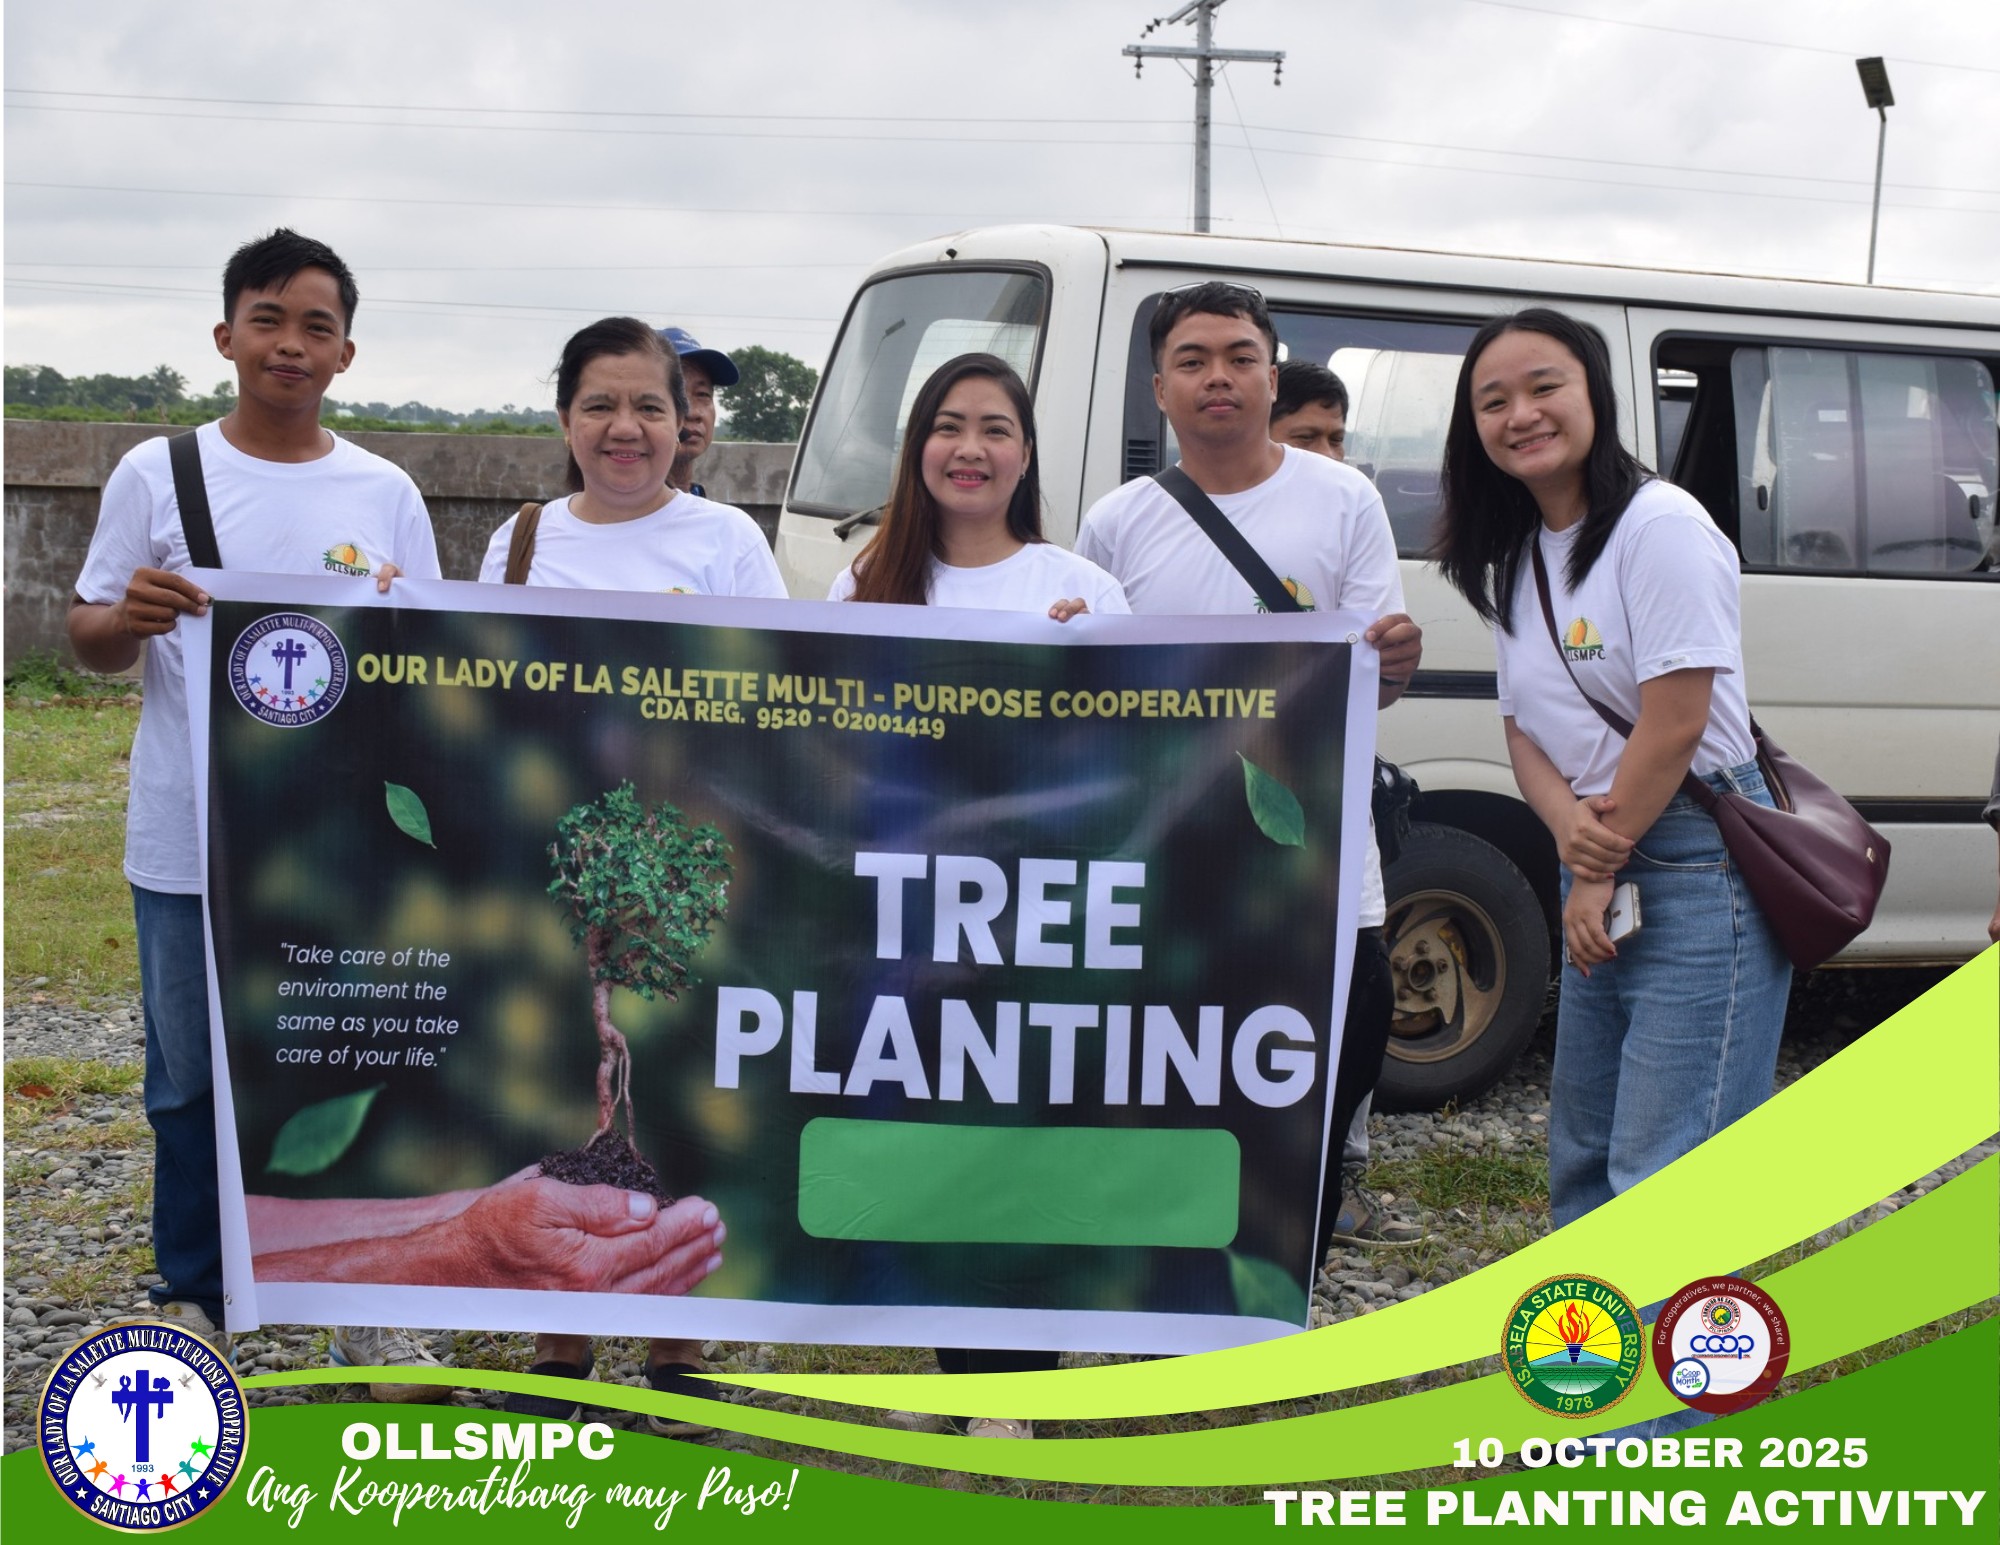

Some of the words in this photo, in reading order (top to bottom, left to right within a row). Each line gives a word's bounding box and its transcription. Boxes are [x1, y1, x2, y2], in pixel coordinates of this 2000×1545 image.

[247, 617, 281, 641] SALETTE
[282, 616, 337, 651] MULTI-PURPOSE
[235, 650, 247, 660] OF
[238, 639, 253, 651] LA
[233, 662, 244, 684] LADY
[324, 651, 345, 704] COOPERATIVE
[236, 684, 252, 701] OUR
[357, 653, 428, 685] OUR
[436, 656, 518, 690] LADY
[524, 661, 567, 692] OF
[574, 664, 613, 694] LA
[620, 666, 759, 702] SALETTE
[767, 672, 866, 707] MULTI
[895, 683, 1042, 718] PURPOSE
[1050, 688, 1277, 719] COOPERATIVE
[257, 706, 298, 724] SANTIAGO
[299, 707, 317, 722] CITY
[641, 698, 690, 720] CDA
[694, 700, 746, 724] REG.
[756, 706, 812, 730] 9520
[854, 852, 1146, 970] TREE
[281, 942, 334, 964] "Take
[339, 950, 386, 965] care
[391, 947, 413, 967] of
[417, 948, 451, 968] the
[277, 977, 409, 999] environment
[414, 981, 447, 1001] the
[276, 1014, 336, 1031] same
[341, 1016, 366, 1032] as
[371, 1017, 409, 1038] you
[415, 1015, 460, 1035] take
[275, 1048, 322, 1064] care
[328, 1045, 350, 1065] of
[354, 1049, 400, 1071] your
[404, 1047, 447, 1067] life."
[714, 986, 1316, 1108] PLANTING
